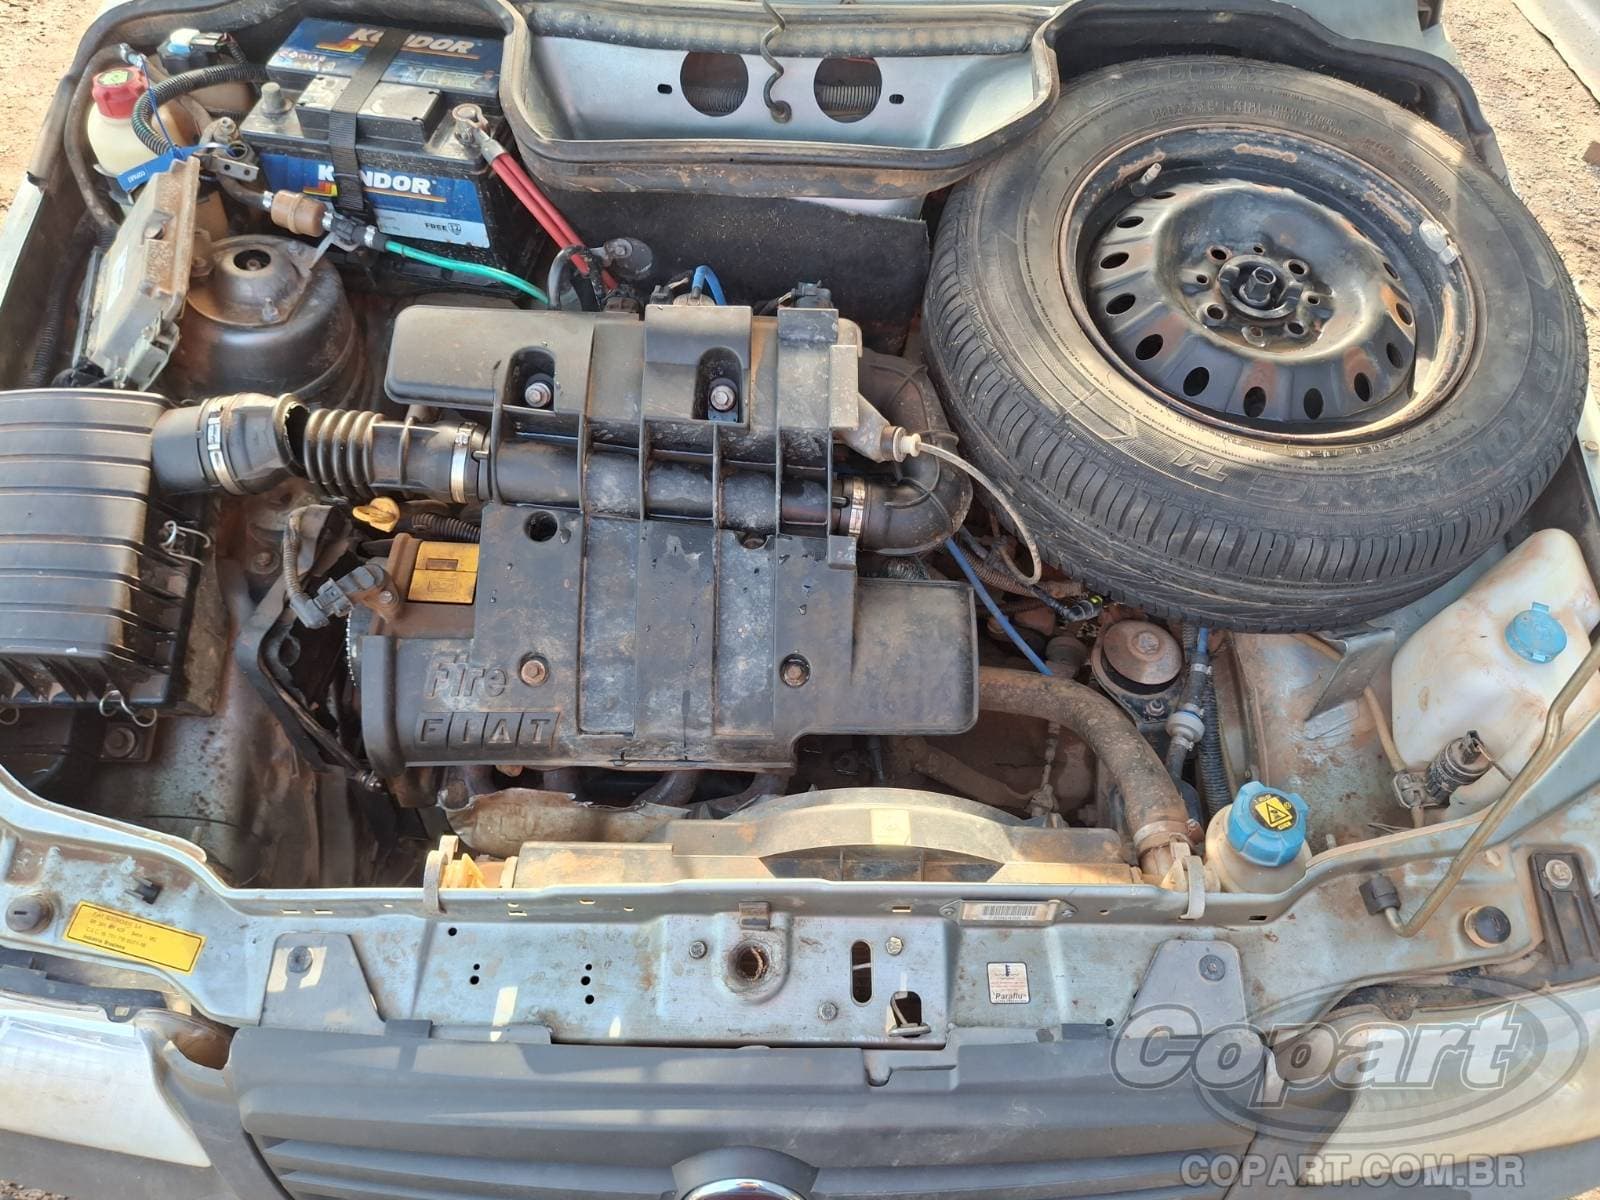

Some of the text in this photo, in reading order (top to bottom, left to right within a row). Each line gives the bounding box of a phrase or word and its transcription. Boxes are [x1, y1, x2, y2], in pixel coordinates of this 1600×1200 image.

[348, 28, 475, 54] KDOR
[318, 164, 432, 195] KNDOR
[425, 222, 447, 232] FREE
[425, 653, 508, 698] Fire
[419, 717, 552, 745] FIAT
